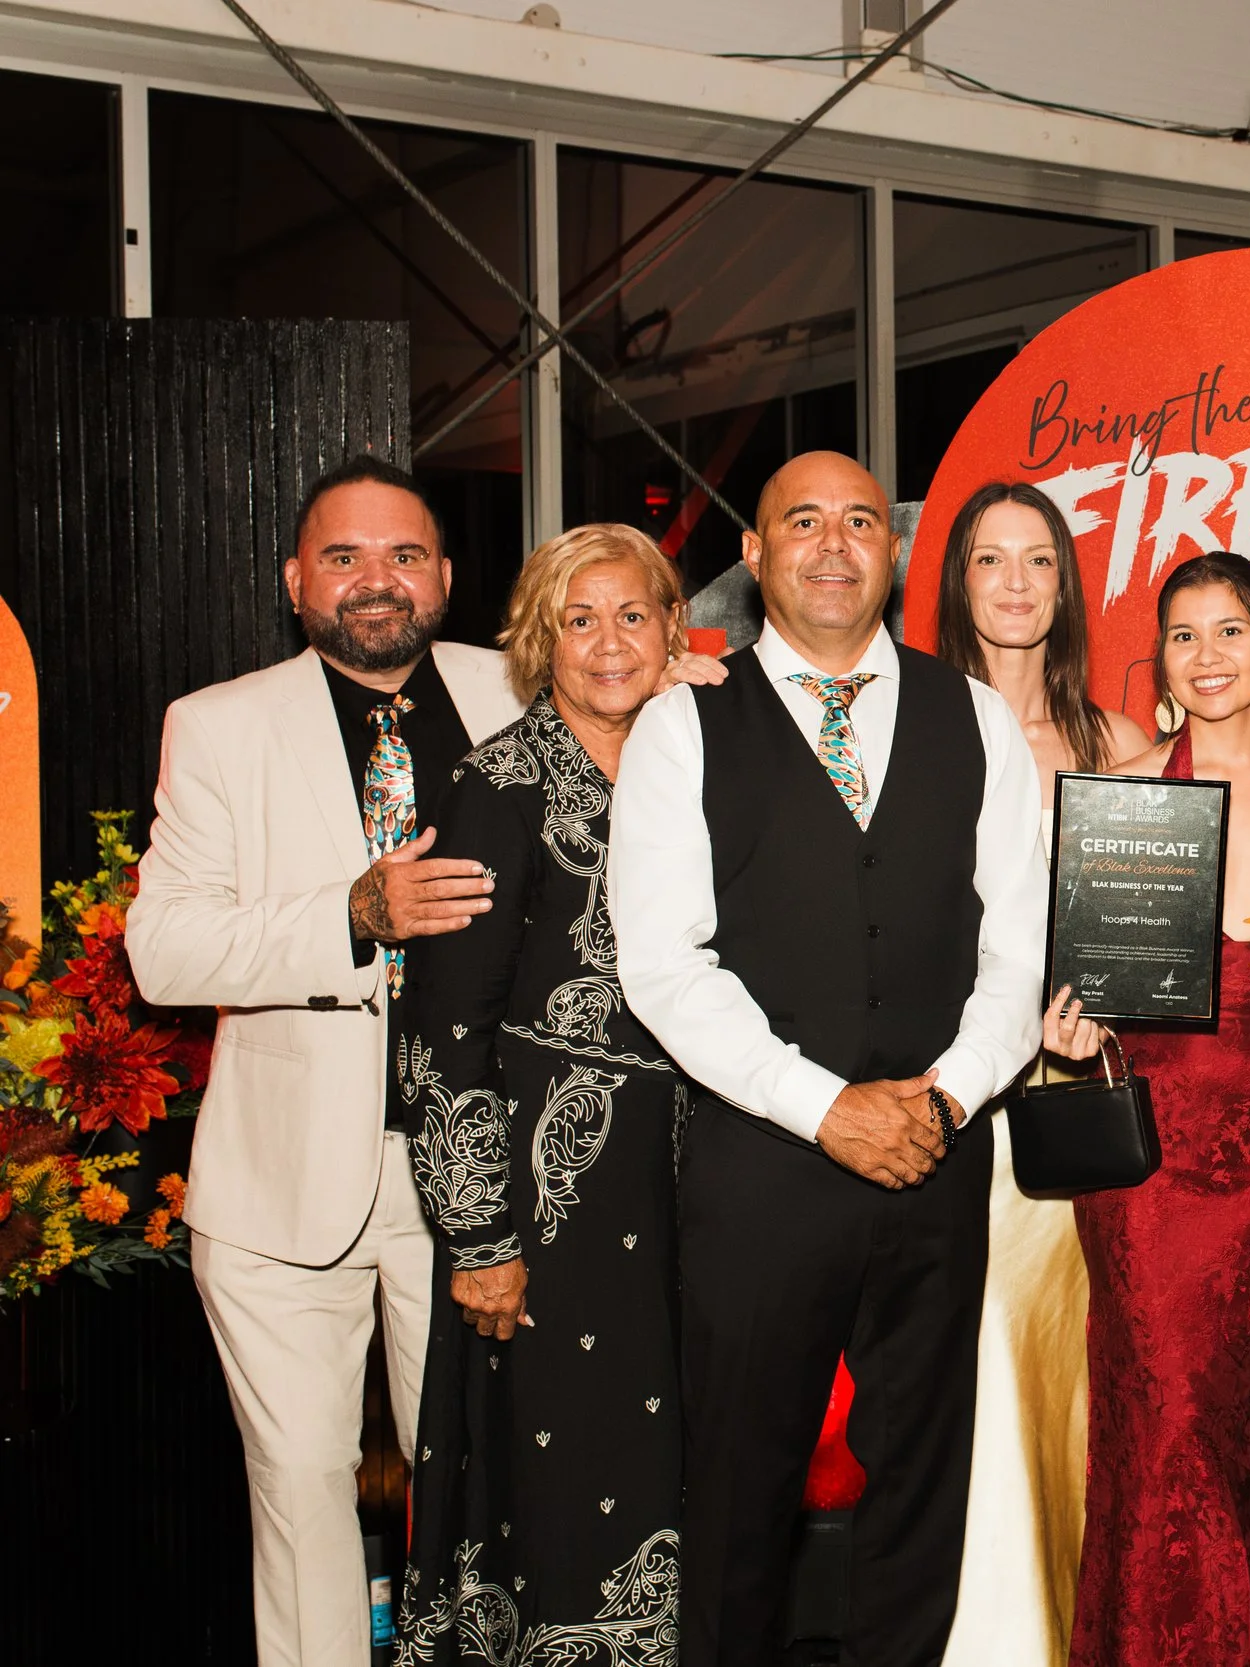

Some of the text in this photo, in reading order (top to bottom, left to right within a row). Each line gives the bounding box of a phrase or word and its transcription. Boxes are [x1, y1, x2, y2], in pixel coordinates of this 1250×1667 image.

[1019, 379, 1179, 477] Bring
[1135, 807, 1175, 817] BUSINESS
[1134, 814, 1169, 824] AWARDS
[1080, 837, 1200, 858] CERTIFICATE
[1082, 857, 1198, 877] of Blak Excellence
[1091, 880, 1184, 892] BLAK BUSINESS OF THE YEAR
[1101, 914, 1171, 927] Hoops 4 Health
